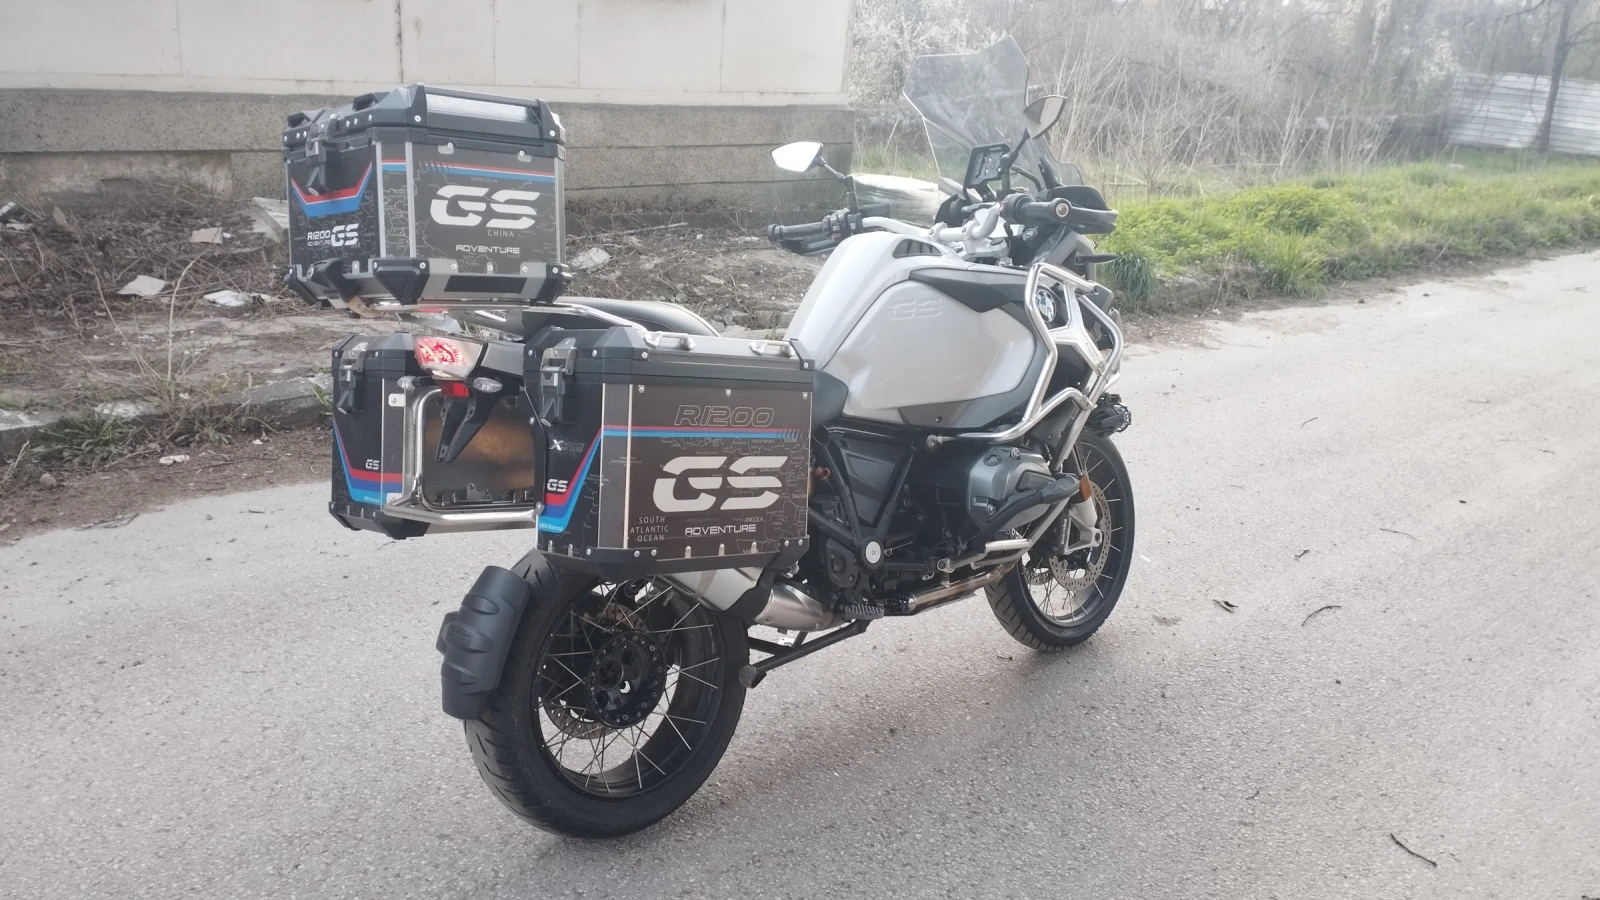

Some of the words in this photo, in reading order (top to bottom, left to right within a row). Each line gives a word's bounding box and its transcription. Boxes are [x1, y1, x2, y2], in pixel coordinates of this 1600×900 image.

[430, 185, 540, 229] GS
[307, 230, 331, 240] R1200
[331, 223, 359, 247] GS
[487, 229, 514, 238] CHINA
[455, 244, 520, 254] ADVENTURE
[674, 405, 774, 427] R1200
[365, 459, 380, 470] GS
[546, 478, 568, 492] GS
[653, 456, 788, 512] GS
[638, 516, 666, 524] SOUTH
[630, 525, 669, 533] ATLANTIC
[684, 524, 757, 536] ADVENTURE
[637, 534, 665, 542] OCEAN
